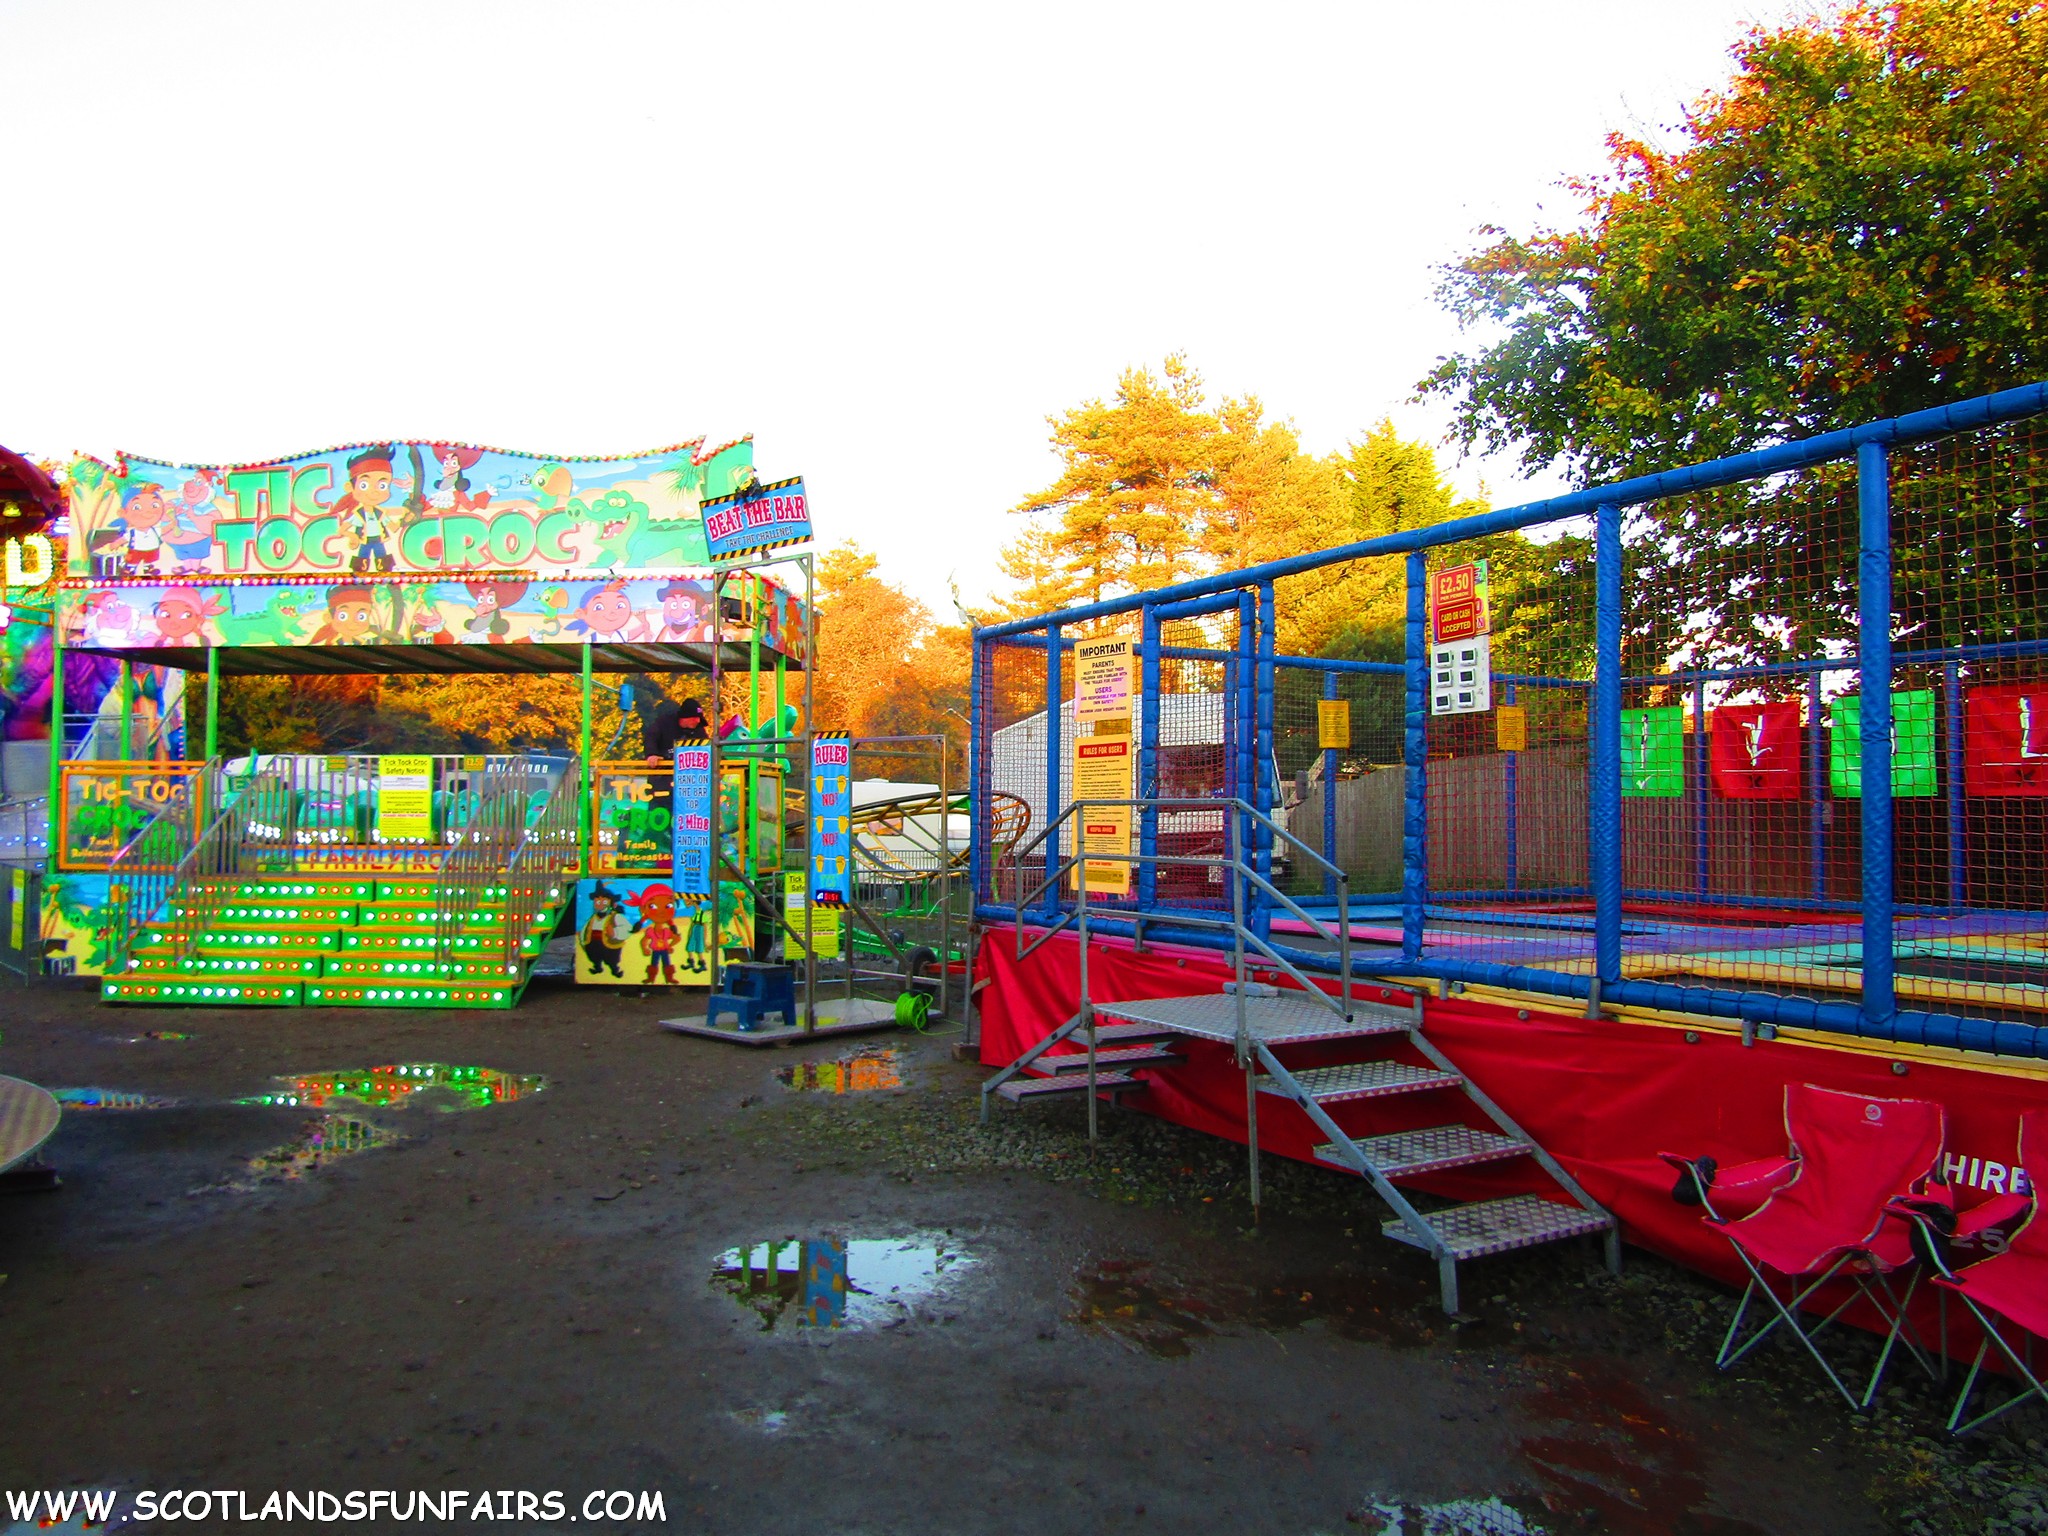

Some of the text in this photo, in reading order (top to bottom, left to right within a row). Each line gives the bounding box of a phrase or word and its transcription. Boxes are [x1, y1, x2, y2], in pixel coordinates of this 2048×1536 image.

[225, 463, 333, 518] TIC
[706, 495, 807, 541] BEAT THE BAR
[212, 513, 344, 572] TOC
[399, 509, 581, 570] CROC
[725, 525, 794, 549] TAKE THE CHALLENGE
[1440, 572, 1469, 595] £2.50
[1441, 608, 1471, 623] CARD OR CASH
[1442, 620, 1471, 635] ACCEPTED
[1080, 642, 1127, 658] IMPORTANT
[1092, 660, 1115, 668] PARENTS
[1095, 686, 1112, 694] USERS
[815, 744, 849, 766] RULES
[1083, 745, 1123, 755] RULES FOR USERS
[384, 758, 396, 766] Tick
[397, 758, 411, 766] Tock
[678, 752, 709, 770] RULES
[386, 767, 405, 775] Safety
[677, 774, 709, 785] HANG ON
[679, 787, 708, 797] THE BAR
[822, 793, 838, 806] NO!
[686, 799, 700, 809] FOR
[612, 807, 673, 832] CRO
[678, 815, 684, 830] 2
[678, 836, 709, 847] AND WIN
[822, 832, 838, 846] NO!
[624, 839, 657, 856] Family
[1943, 1152, 2026, 1194] HIRE
[1950, 1228, 2008, 1253] 5
